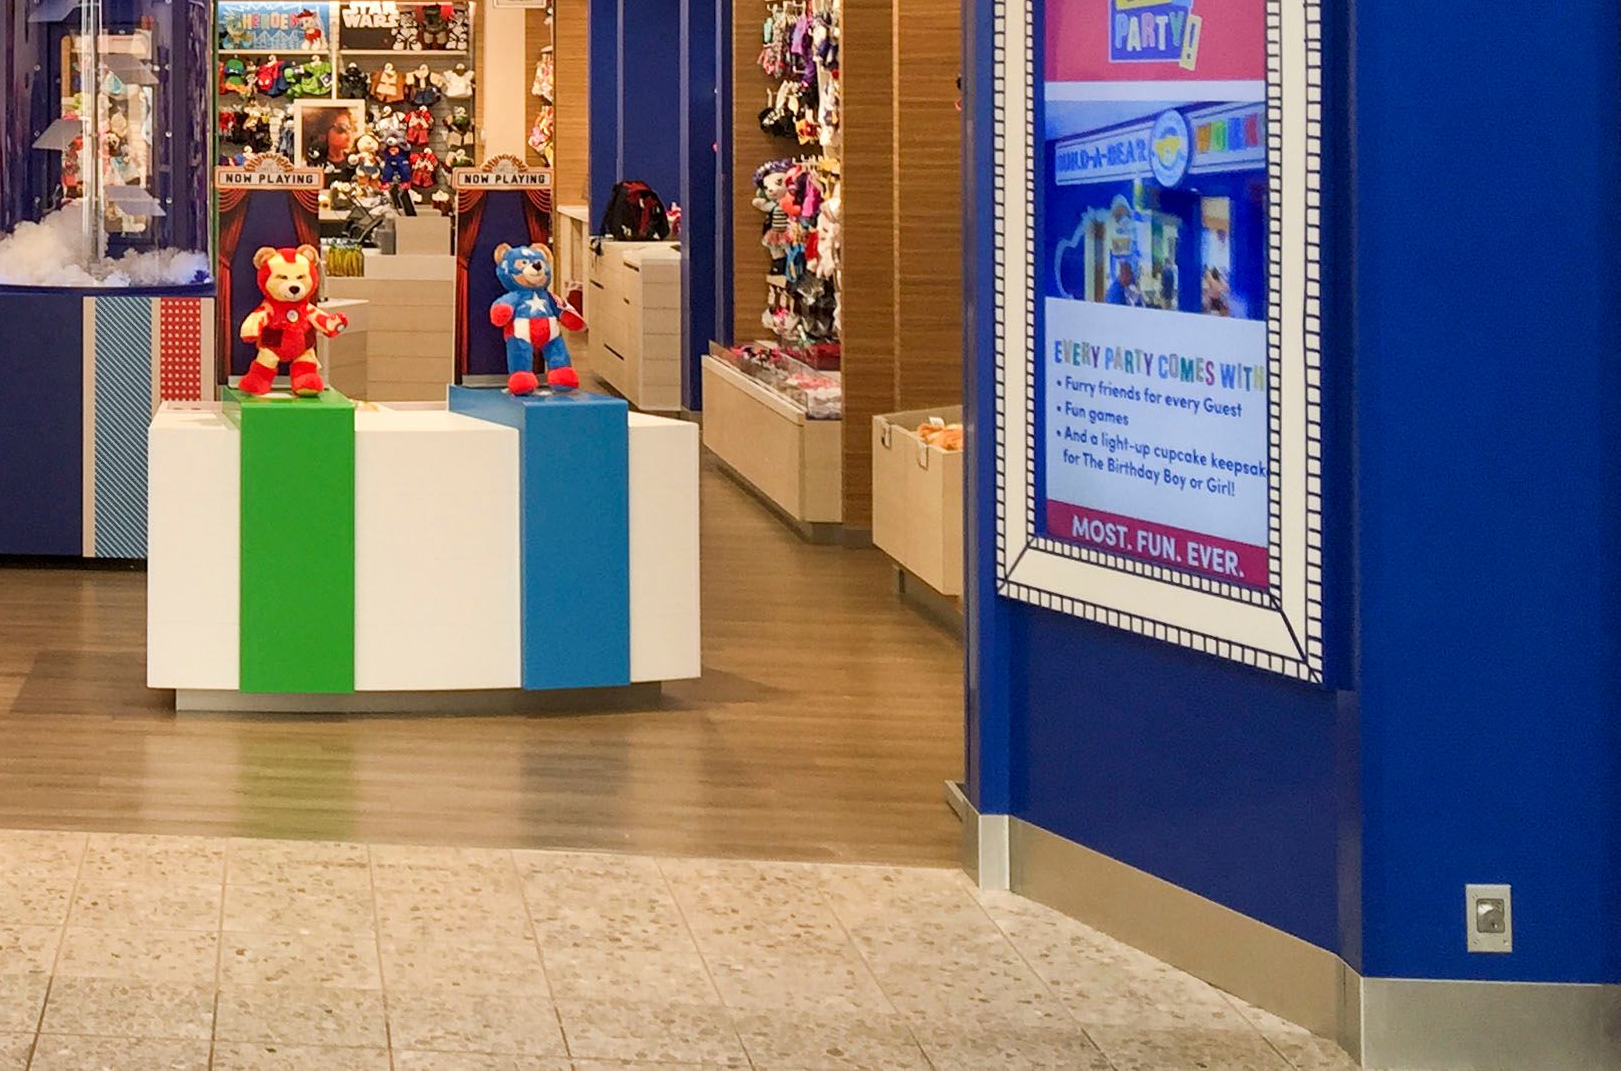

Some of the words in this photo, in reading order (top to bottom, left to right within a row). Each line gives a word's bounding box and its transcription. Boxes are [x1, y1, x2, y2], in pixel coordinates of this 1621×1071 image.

[342, 0, 400, 15] STAR
[342, 14, 402, 29] WARS
[225, 173, 252, 183] NOW
[258, 174, 313, 184] PLAYING
[464, 174, 489, 184] NOW
[495, 174, 546, 184] PLAYING
[1054, 339, 1101, 369] EVERY
[1104, 346, 1154, 377] PARTY
[1157, 353, 1216, 387] COMES
[1219, 362, 1265, 392] WITH
[1065, 375, 1096, 398] Furry
[1098, 380, 1141, 401] friends
[1144, 387, 1162, 404] for
[1165, 395, 1200, 415] every
[1203, 397, 1243, 418] Guest
[1065, 400, 1086, 418] Fun
[1089, 407, 1129, 426] games
[1064, 426, 1087, 444] And
[1090, 435, 1098, 446] a
[1101, 431, 1151, 459] light-up
[1153, 444, 1207, 466] cupcake
[1063, 448, 1081, 465] for
[1082, 452, 1104, 471] The
[1107, 457, 1160, 485] Birthday
[1163, 468, 1187, 491] Boy
[1189, 478, 1203, 491] or
[1206, 478, 1236, 497] Girl!
[1072, 514, 1132, 551] MOST.
[1136, 529, 1182, 562] FUN.
[1187, 541, 1246, 578] EVER.
